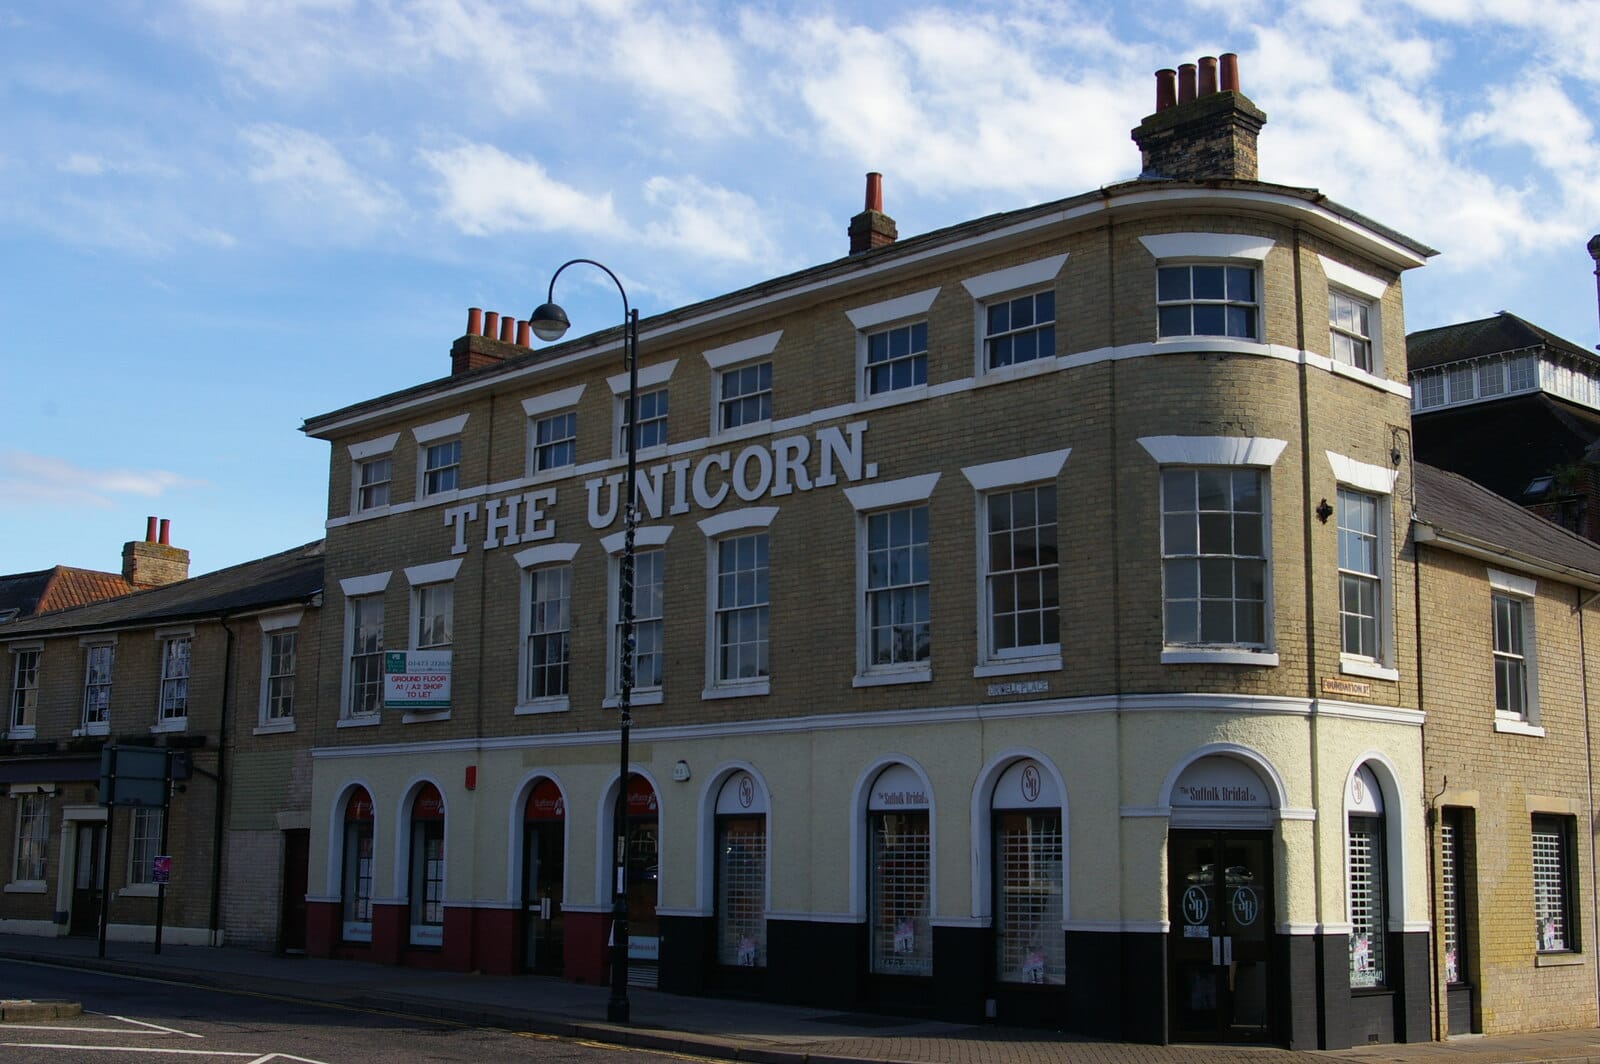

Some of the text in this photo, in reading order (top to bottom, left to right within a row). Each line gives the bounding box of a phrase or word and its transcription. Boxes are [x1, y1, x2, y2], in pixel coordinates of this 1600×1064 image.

[444, 487, 558, 555] THE
[884, 791, 905, 805] Suffolk
[905, 791, 924, 804] Bridal
[1189, 786, 1220, 801] Suffolk
[1222, 786, 1249, 801] Bridal
